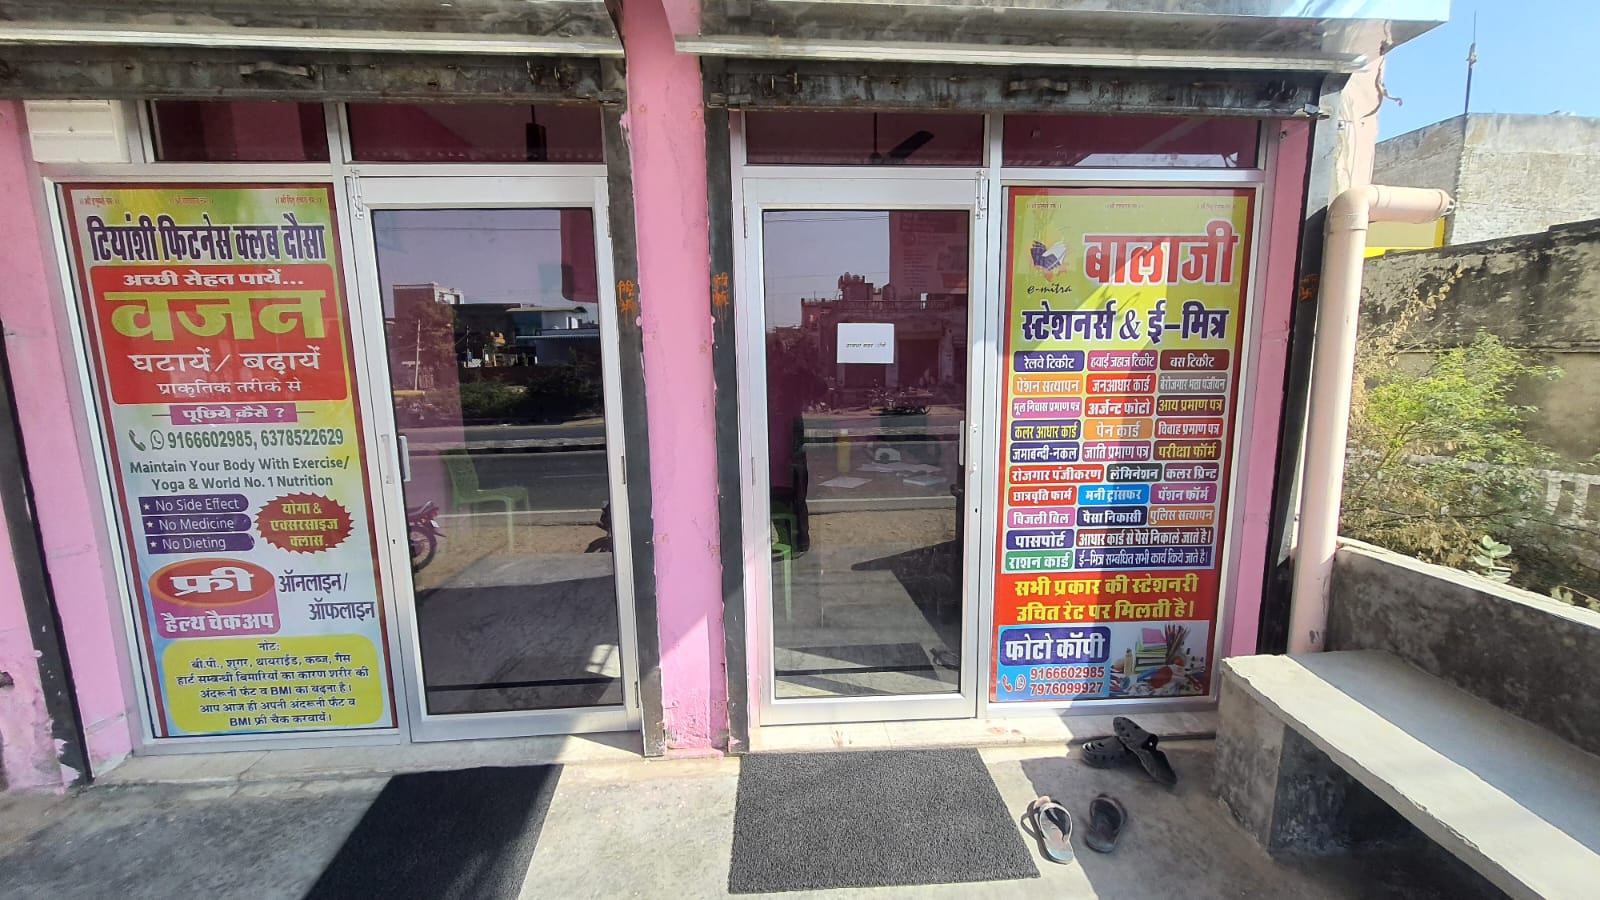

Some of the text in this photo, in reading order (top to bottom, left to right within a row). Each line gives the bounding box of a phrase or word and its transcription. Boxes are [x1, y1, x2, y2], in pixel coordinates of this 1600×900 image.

[87, 212, 326, 261] टियांशी फिटनेस क्लब दौसा
[1084, 219, 1239, 284] बालाजी
[123, 270, 179, 287] अच्छी
[184, 269, 234, 286] सेहत
[1026, 283, 1073, 295] e-mitra
[103, 289, 327, 341] वजन
[1021, 300, 1117, 341] स्टेशनर्स
[1118, 309, 1141, 341] &
[1023, 353, 1075, 369] रेलवे टिकीट
[1090, 352, 1110, 369] हवाई
[1131, 352, 1155, 368] टिकीट
[1170, 352, 1215, 368] बस टिकीट
[156, 376, 302, 398] प्राकृतिक तरीके से
[1042, 380, 1081, 393] सत्यापन
[1132, 375, 1151, 392] कार्ड
[182, 406, 231, 423] पूछिये
[236, 404, 269, 419] कैसे
[1013, 399, 1080, 416] मूल निवास प्रमाण पत्र
[1123, 398, 1151, 415] फोटो
[1158, 399, 1223, 412] आय प्रमाण पत्र
[1014, 420, 1079, 439] कलर आधार कार्ड
[1116, 420, 1141, 438] कार्ड
[1158, 420, 1220, 436] विवाह प्रमाण पत्र
[1083, 442, 1150, 460] जाति प्रमाण पत्र
[1158, 441, 1217, 459] परीक्षा फॉर्म
[130, 461, 187, 474] Maintain
[189, 459, 220, 472] Your
[223, 459, 255, 473] Body
[258, 457, 289, 470] With
[1012, 466, 1102, 482] रोजगार पंजीकरण
[1166, 465, 1217, 480] कलर प्रिन्ट
[151, 475, 333, 492] Yoga & World No. Nutrition
[1050, 487, 1073, 501] फार्म
[1085, 486, 1142, 504] मनी ट्रांसफर
[1185, 485, 1210, 501] फॉर्म
[155, 497, 240, 512] No Side Effect
[280, 500, 322, 515] योगा &
[159, 517, 235, 531] No Medicine
[1013, 510, 1070, 525] बिजली बिल
[1082, 508, 1142, 524] पैसा निकासी
[1149, 507, 1214, 525] पुलिस सत्यापन
[162, 536, 226, 551] No Dieting
[1014, 530, 1067, 548] पासपोर्ट
[1079, 532, 1106, 546] आधार
[1106, 528, 1126, 546] कार्ड
[1150, 528, 1181, 545] निकाले
[1181, 528, 1200, 544] जाते
[1008, 551, 1071, 570] राशन कार्ड
[1134, 548, 1151, 565] सभी
[169, 566, 255, 597] फ्री
[1014, 572, 1200, 596] सभी प्रकार की स्टेशनरी
[307, 597, 375, 622] ऑफलाइन
[1015, 601, 1061, 622] उचित
[1062, 600, 1086, 621] रेट
[1088, 604, 1114, 620] पर
[1114, 598, 1172, 619] मिलती
[160, 612, 206, 633] हैल्थ
[1005, 631, 1106, 661] फोटो कॉपी
[175, 673, 194, 686] हार्ट
[280, 671, 294, 680] का
[297, 669, 327, 680] कारण
[328, 666, 353, 678] शरीर
[355, 665, 369, 677] की
[1030, 666, 1105, 681] 9166602985
[259, 686, 268, 695] व
[270, 686, 292, 696] BMI
[295, 685, 309, 695] का
[1029, 682, 1104, 696] 7976099927
[200, 704, 220, 713] आप
[222, 703, 245, 713] आज
[246, 699, 258, 712] ही
[260, 698, 287, 711] अपनी
[347, 698, 356, 706] व
[229, 712, 291, 727] BMI फ्री चैक
